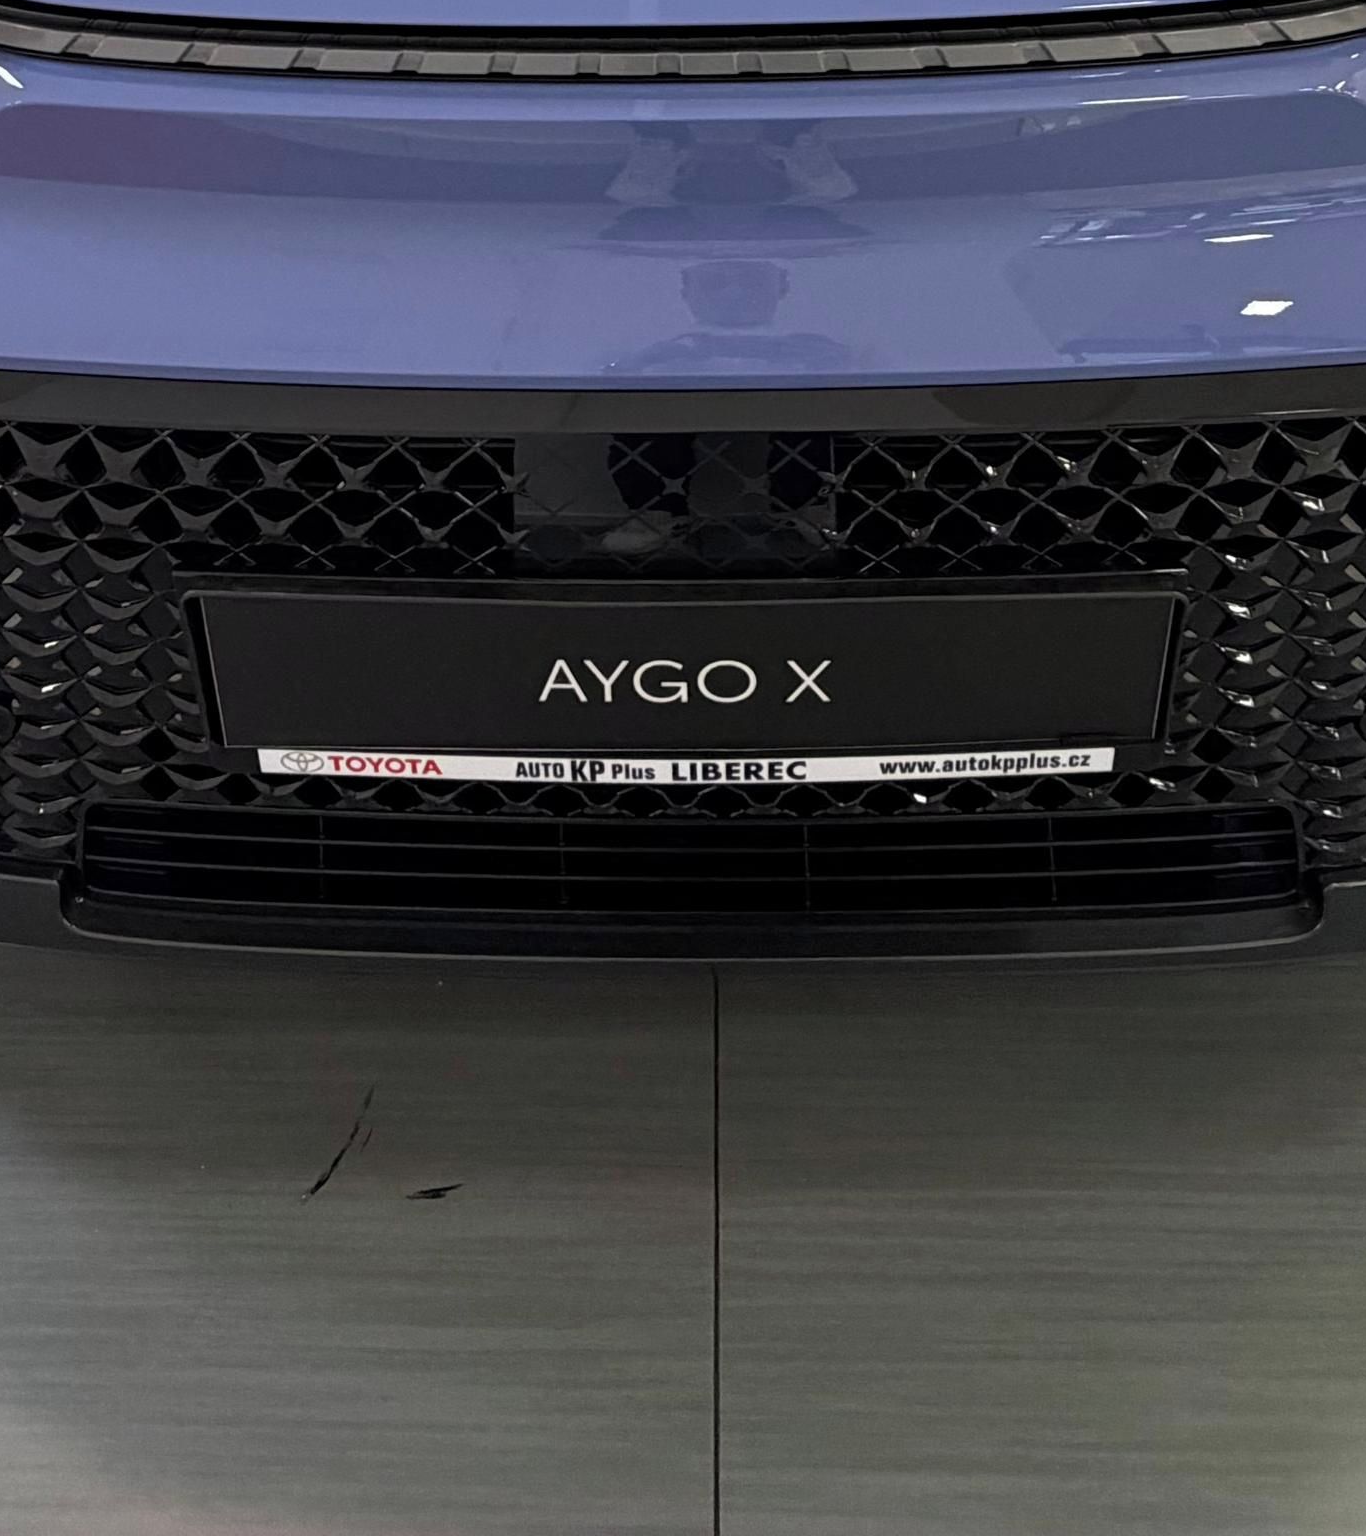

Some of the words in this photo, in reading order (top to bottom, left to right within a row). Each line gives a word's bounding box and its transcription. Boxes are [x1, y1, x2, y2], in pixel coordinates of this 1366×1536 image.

[539, 659, 757, 703] AYGO
[785, 659, 832, 703] X
[328, 755, 443, 775] TOYOTA
[515, 762, 565, 779] AUTO
[570, 759, 605, 782] KP
[611, 763, 656, 780] Plus
[671, 761, 808, 781] LIBEREC
[879, 753, 1092, 774] www.autokpplus.cz
